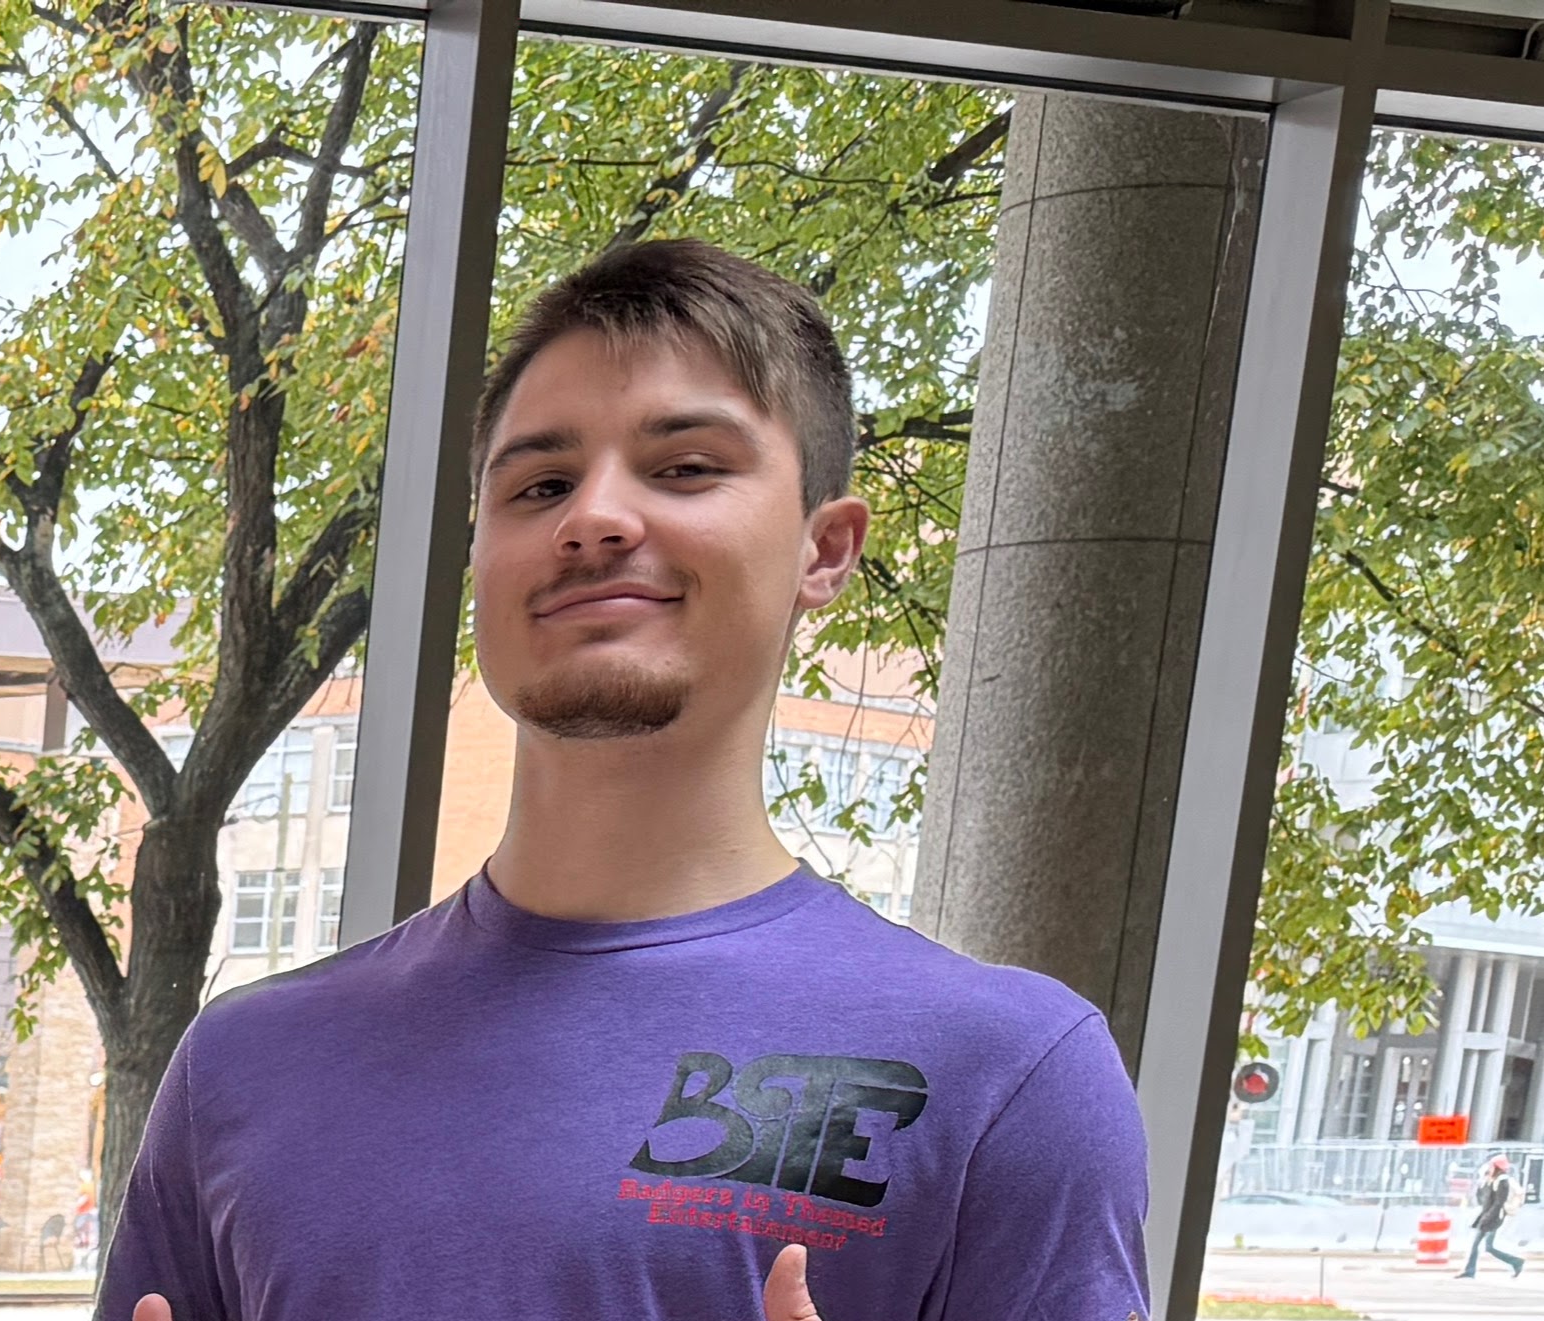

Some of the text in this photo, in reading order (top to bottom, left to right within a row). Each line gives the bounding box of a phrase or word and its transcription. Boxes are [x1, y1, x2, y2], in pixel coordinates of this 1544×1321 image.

[617, 1179, 733, 1206] Badgers
[782, 1194, 887, 1237] Themed
[647, 1201, 848, 1250] Entertainment
